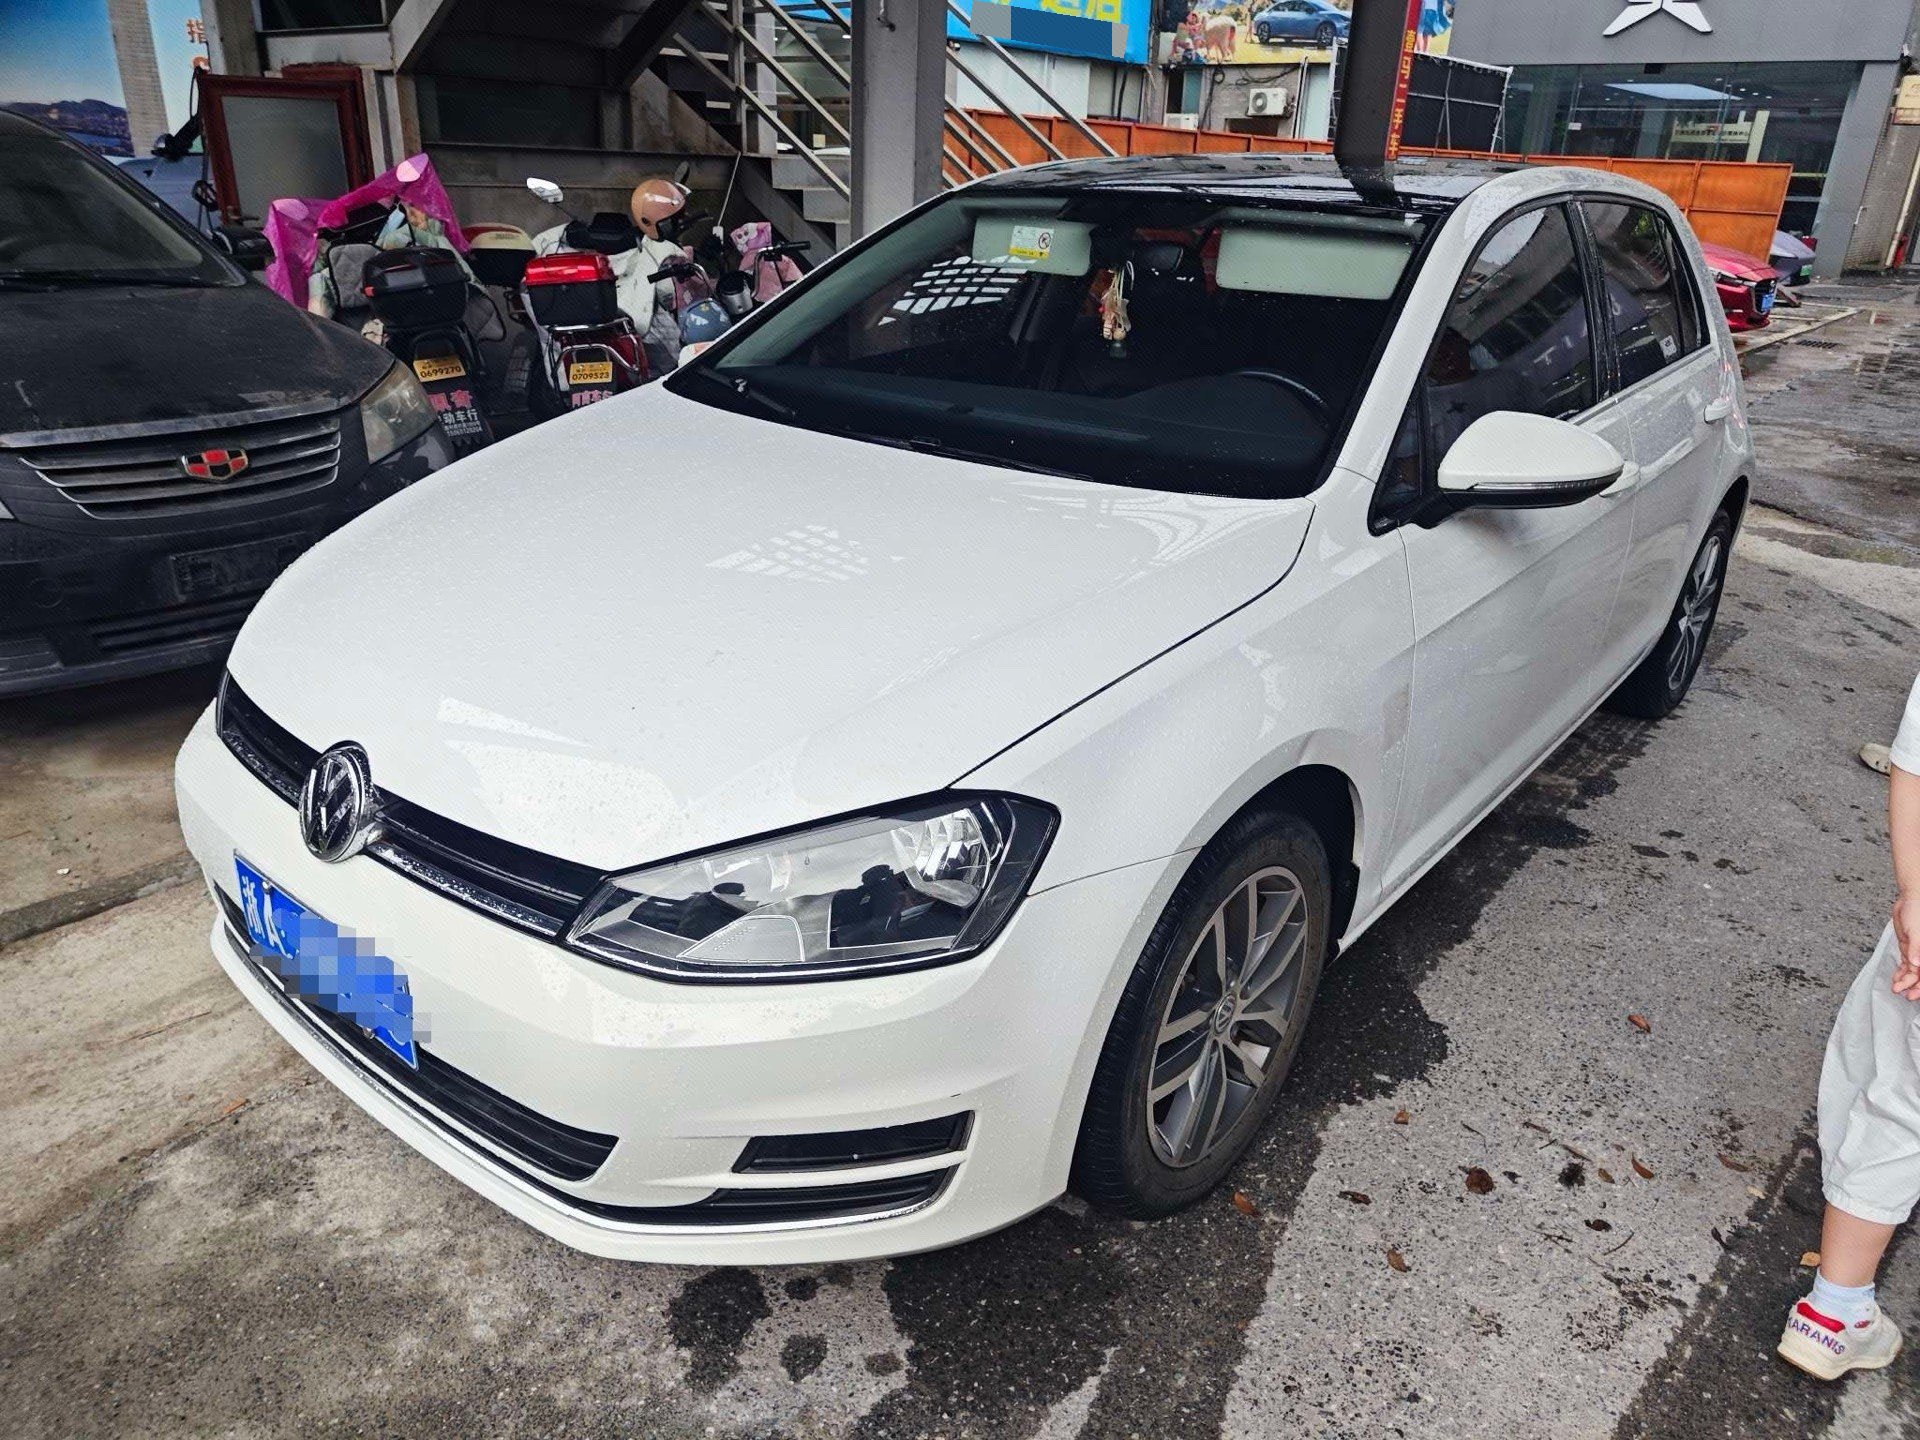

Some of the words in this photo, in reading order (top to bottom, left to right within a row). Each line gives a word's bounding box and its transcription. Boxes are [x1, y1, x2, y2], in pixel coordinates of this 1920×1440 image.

[420, 366, 461, 378] 0699270
[438, 408, 479, 424] 动车行
